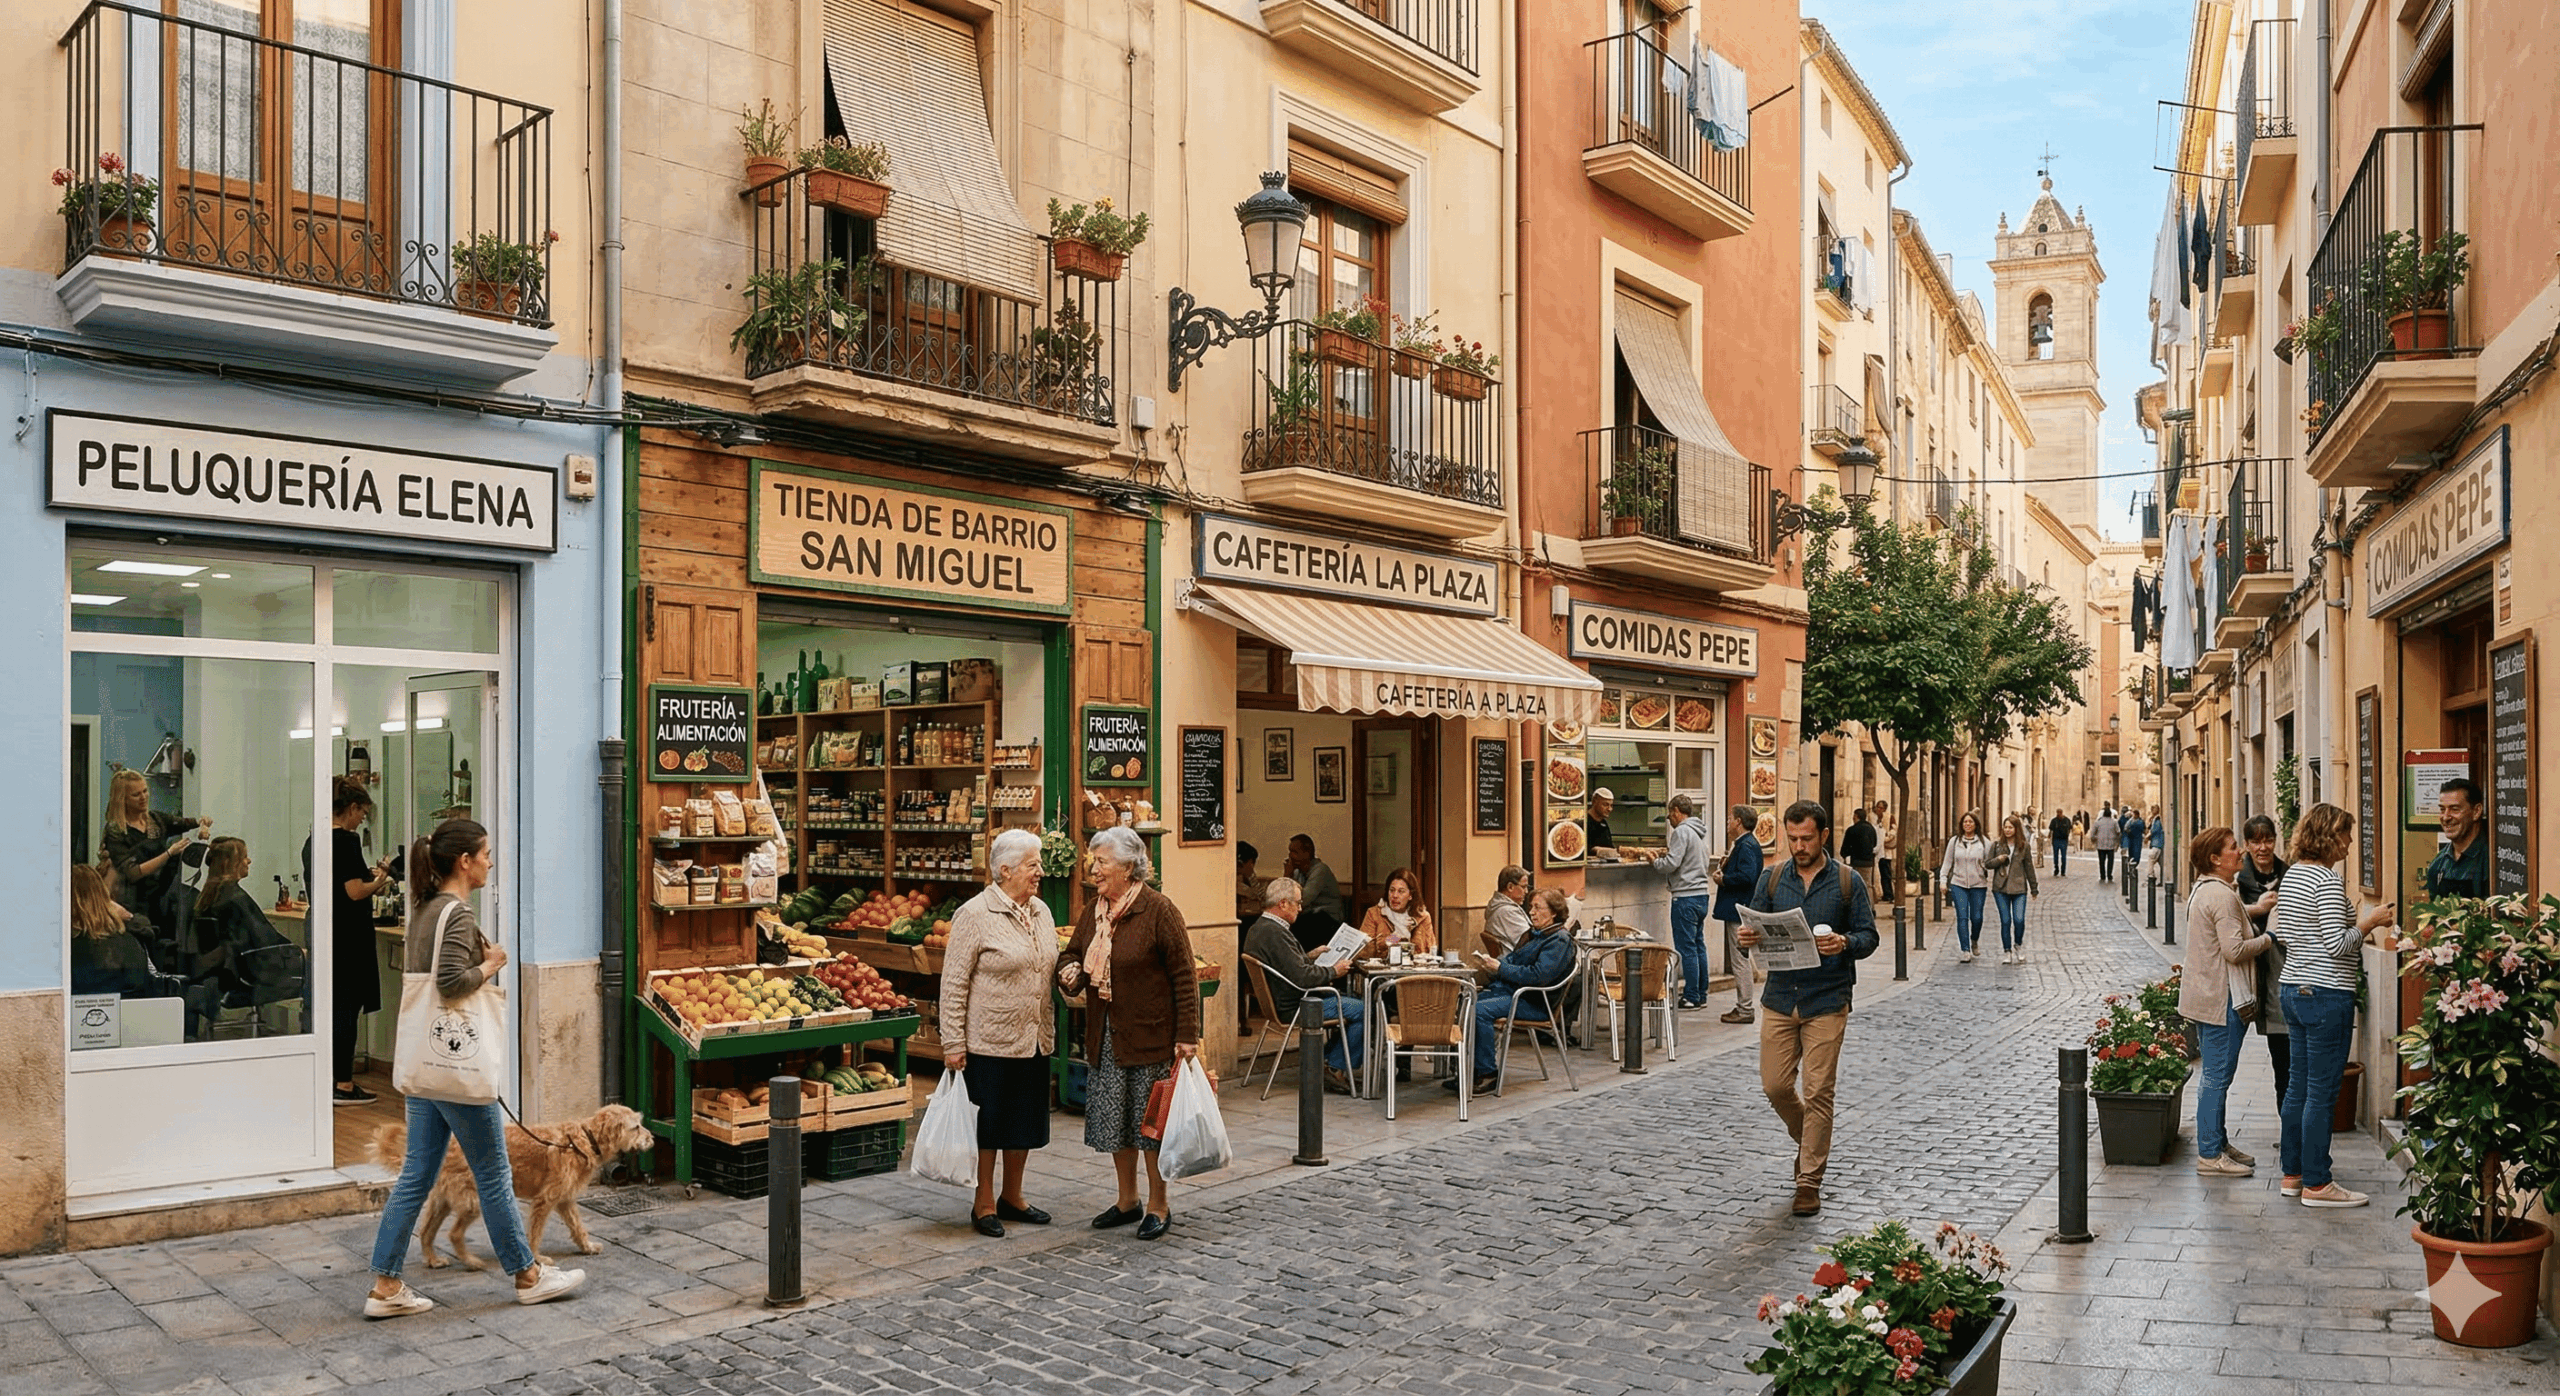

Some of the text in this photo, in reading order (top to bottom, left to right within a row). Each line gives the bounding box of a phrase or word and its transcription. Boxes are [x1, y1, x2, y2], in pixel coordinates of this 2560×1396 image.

[78, 440, 535, 530] PELUQUERÍA ELENA
[773, 482, 1057, 552] TIENDA DE BARRIO
[2373, 458, 2493, 596] COMIDAS PEPE
[800, 530, 1034, 594] SAN MIGUEL
[1213, 530, 1489, 605] CAFETERÍA LA PLAZA
[1582, 613, 1750, 667] COMIDAS PEPE
[659, 695, 737, 720] FRUTERÍA
[1089, 714, 1141, 735] FRUTERÍA
[1376, 682, 1548, 716] CAFETERÍA A PLAZA
[656, 721, 747, 742] ALIMENTACIÓN
